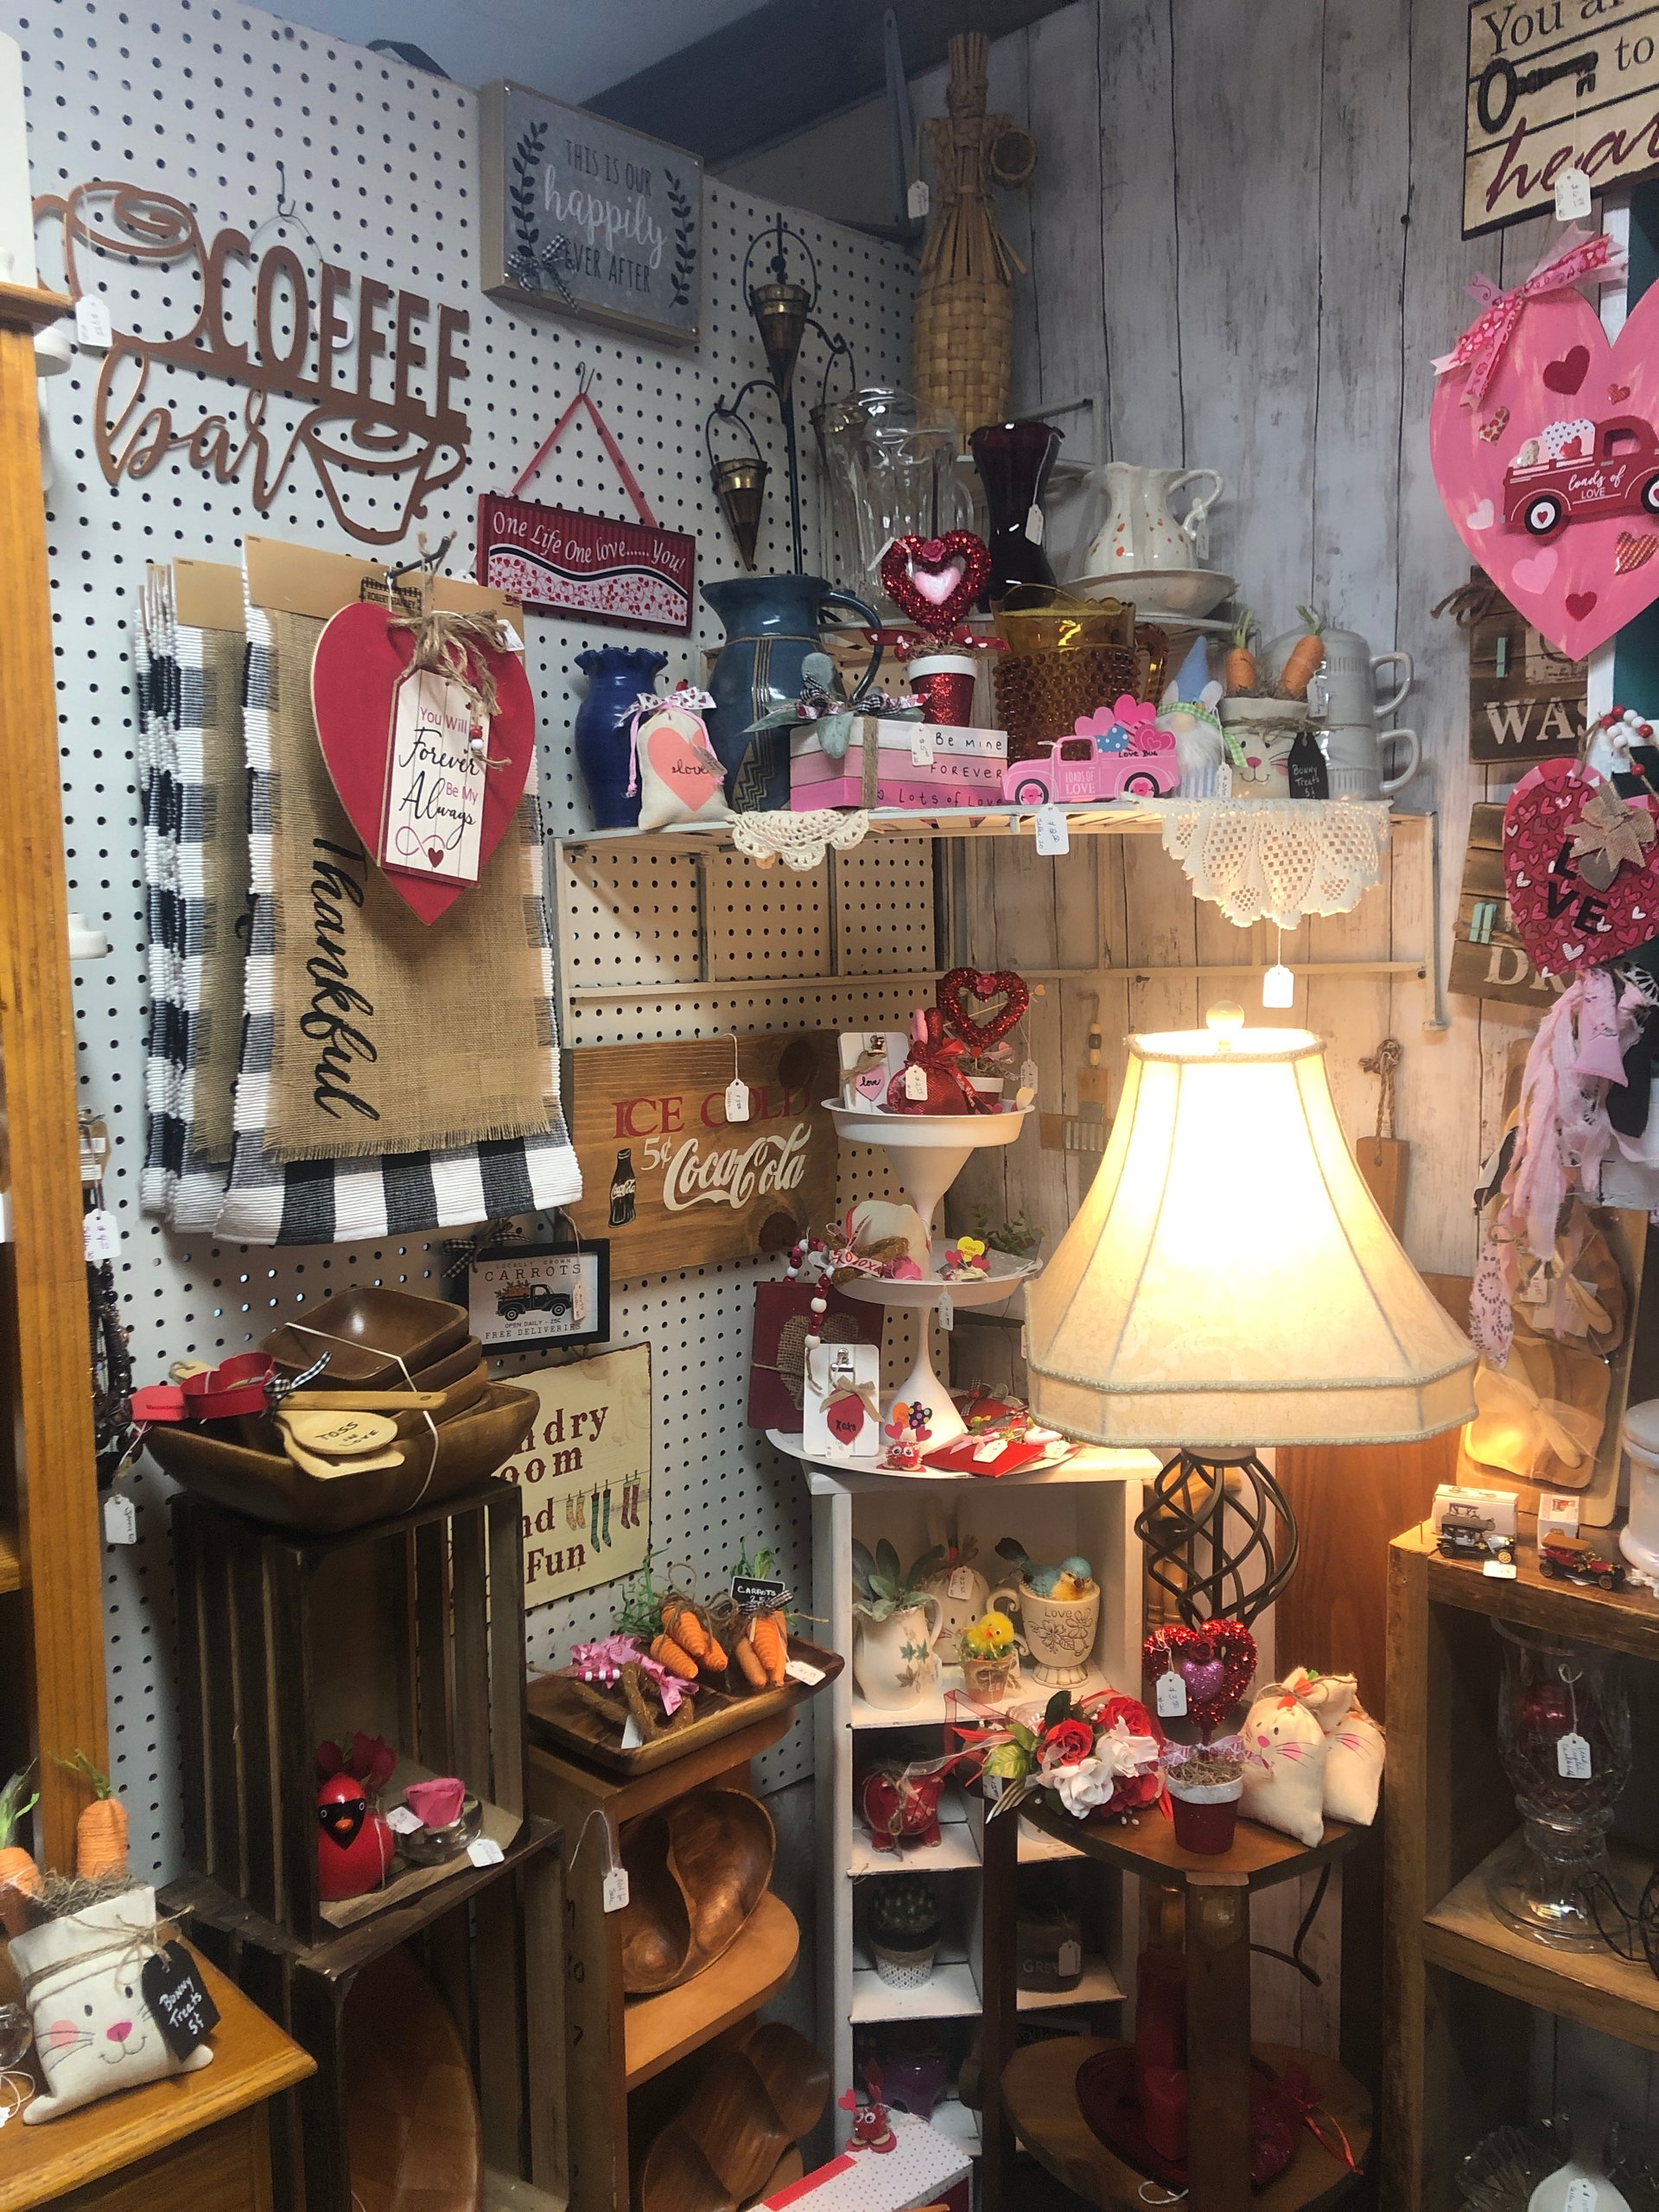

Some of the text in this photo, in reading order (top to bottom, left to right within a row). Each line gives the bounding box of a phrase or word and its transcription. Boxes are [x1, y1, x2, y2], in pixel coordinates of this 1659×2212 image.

[1481, 3, 1565, 56] You
[1614, 35, 1656, 72] to
[565, 139, 652, 197] THIS IS OUR
[544, 164, 668, 270] happily
[564, 238, 652, 294] EVER AFTER
[208, 228, 472, 420] COFFEE
[94, 345, 299, 512] bar
[1567, 465, 1626, 492] loads of
[1581, 487, 1605, 499] LOVE
[493, 512, 527, 537] One
[530, 524, 563, 556] Life
[564, 540, 593, 563] One
[651, 539, 686, 574] You!
[420, 706, 467, 734] You Will
[397, 726, 480, 776] Forever
[935, 732, 954, 747] Be
[671, 759, 709, 775] love
[1065, 770, 1095, 784] LOADS OF
[445, 782, 479, 805] Be My
[946, 791, 961, 808] of
[1065, 783, 1096, 795] LOVE
[398, 771, 476, 851] Always
[859, 1076, 881, 1087] love
[612, 1096, 685, 1140] ICE
[640, 1135, 672, 1171] 5¢
[485, 1263, 581, 1282] CARROTS
[485, 1324, 581, 1339] FREE DELIVERIES
[314, 1421, 359, 1440] TOSS
[339, 1429, 379, 1447] LOVE
[342, 1433, 358, 1442] IN
[525, 1542, 587, 1584] Fun
[737, 1586, 777, 1597] CARROTS
